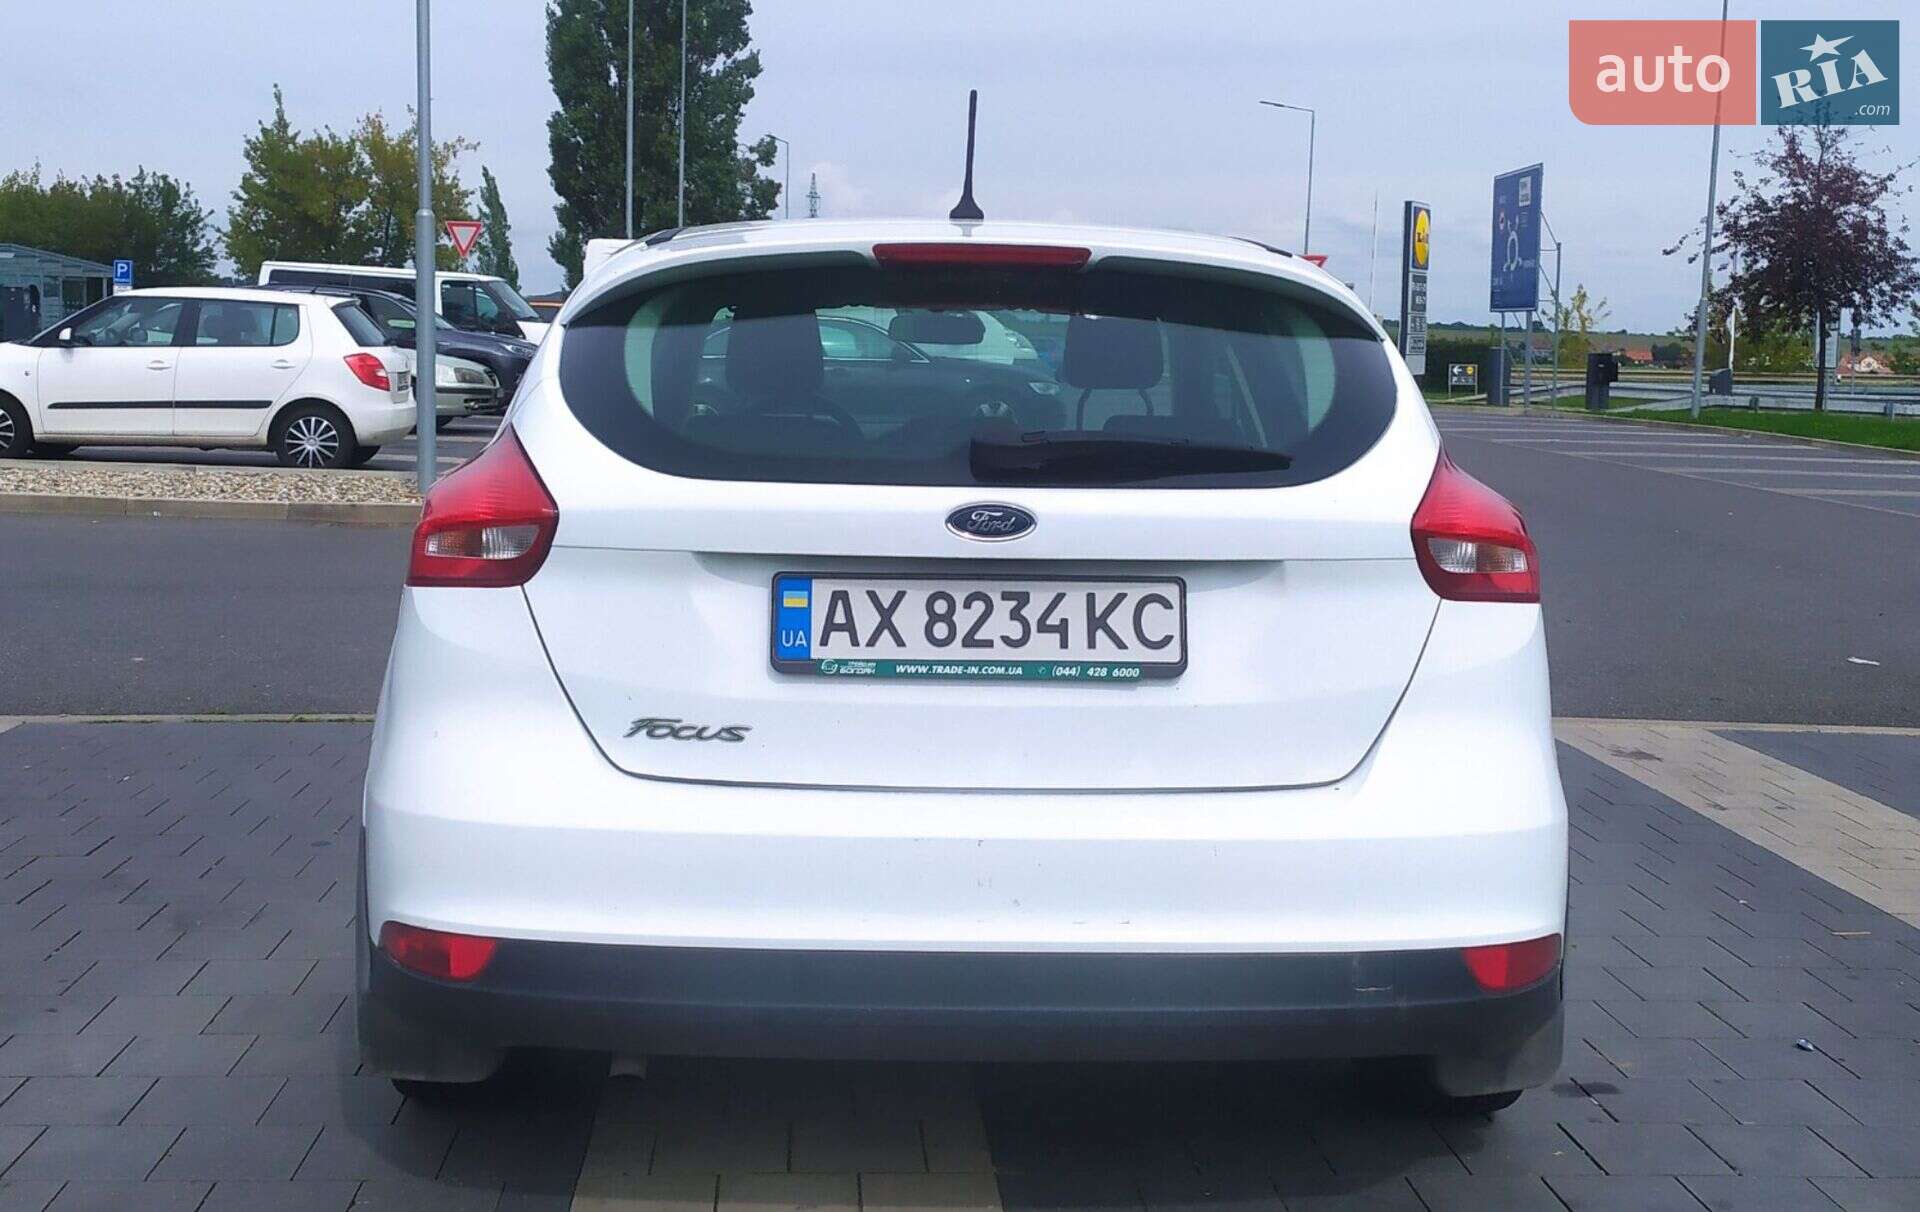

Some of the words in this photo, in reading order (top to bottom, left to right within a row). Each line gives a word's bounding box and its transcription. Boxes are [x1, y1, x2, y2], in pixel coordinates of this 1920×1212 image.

[117, 263, 128, 278] P
[966, 510, 1016, 532] Ford
[819, 590, 907, 648] AX
[924, 590, 1069, 650] 8234
[1086, 592, 1174, 650] KC
[781, 630, 808, 648] UA
[895, 664, 1023, 676] WWW.TRADE-IN.COM.UA
[1051, 666, 1081, 677] (044)
[1087, 667, 1108, 677] 428
[1112, 667, 1140, 678] 6000
